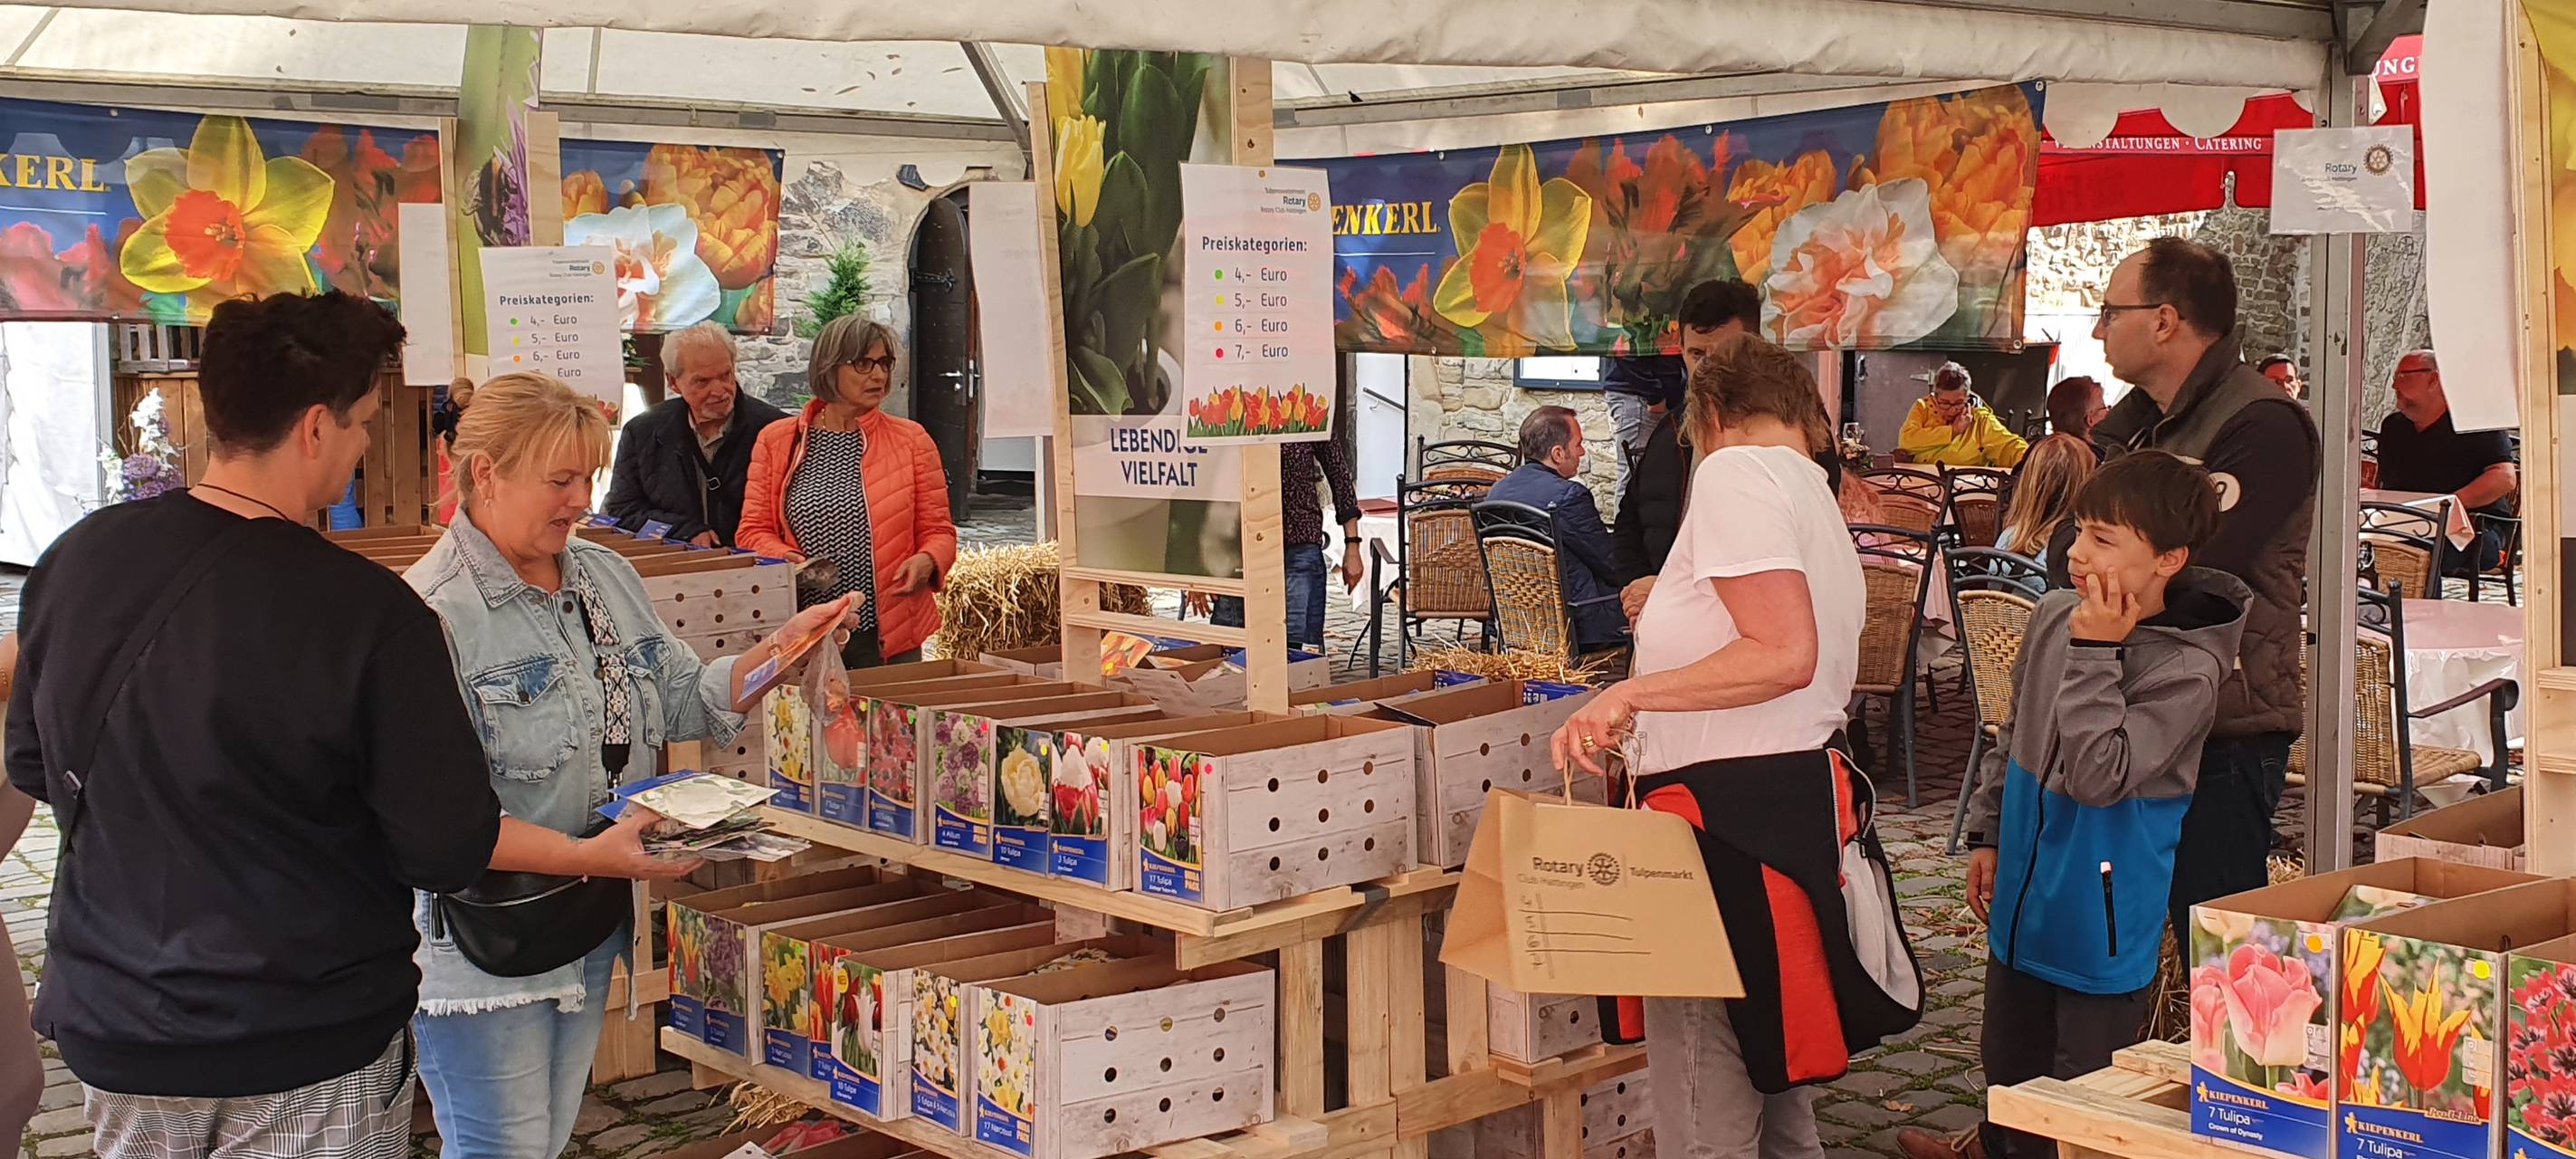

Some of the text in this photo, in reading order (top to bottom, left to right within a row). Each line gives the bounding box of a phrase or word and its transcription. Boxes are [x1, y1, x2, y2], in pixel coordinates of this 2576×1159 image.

[2194, 136, 2262, 150] CATERING
[2325, 162, 2358, 175] Rotary
[1283, 196, 1306, 207] Rotary
[1202, 236, 1308, 254] Preiskategorien:
[1235, 267, 1287, 283] 4,- Euro
[500, 293, 594, 306] Preiskategorien:
[1235, 292, 1287, 309] 5,- Euro
[530, 314, 577, 327] 4,- Euro
[1235, 319, 1288, 335] 6,- Euro
[531, 332, 579, 345] 5,- Euro
[532, 350, 580, 362] 6,- Euro
[1235, 344, 1289, 359] 7,- Euro
[558, 368, 581, 378] Euro
[1121, 460, 1197, 487] VIELFALT
[1532, 857, 1584, 877] Rotary
[1629, 867, 1693, 880] Tulpenmarkt
[2209, 1089, 2269, 1110] KIEPENKERL
[2208, 1106, 2251, 1125] 7 Tulipa
[2429, 1106, 2480, 1123] Profi-Line
[2208, 1123, 2229, 1133] Crown
[2237, 1128, 2263, 1141] Dynasty
[2357, 1121, 2424, 1143] KIEPENKERL
[2356, 1137, 2403, 1159] 7 Tulipa
